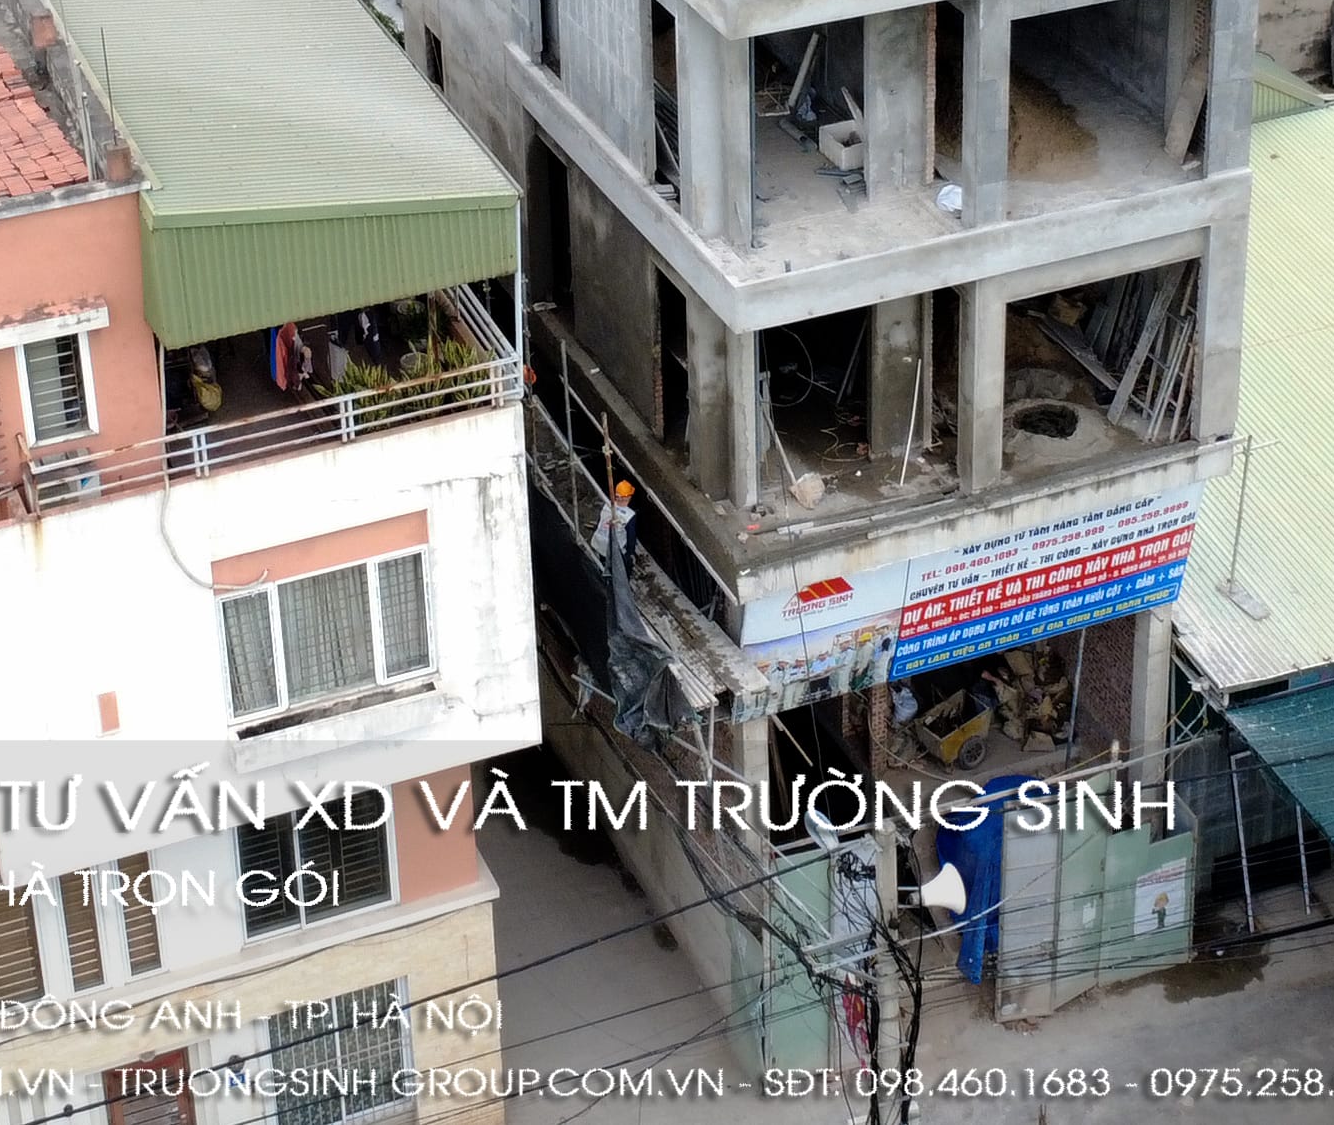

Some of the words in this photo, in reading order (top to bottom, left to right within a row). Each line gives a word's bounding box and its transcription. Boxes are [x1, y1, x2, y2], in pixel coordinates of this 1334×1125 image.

[903, 608, 922, 625] DỰ
[950, 589, 983, 611] THIẾT
[1005, 579, 1021, 595] VÀ
[1026, 575, 1045, 590] THI
[1048, 564, 1082, 583] CÔNG
[1084, 556, 1109, 573] XÂY
[1111, 547, 1135, 566] NHÀ
